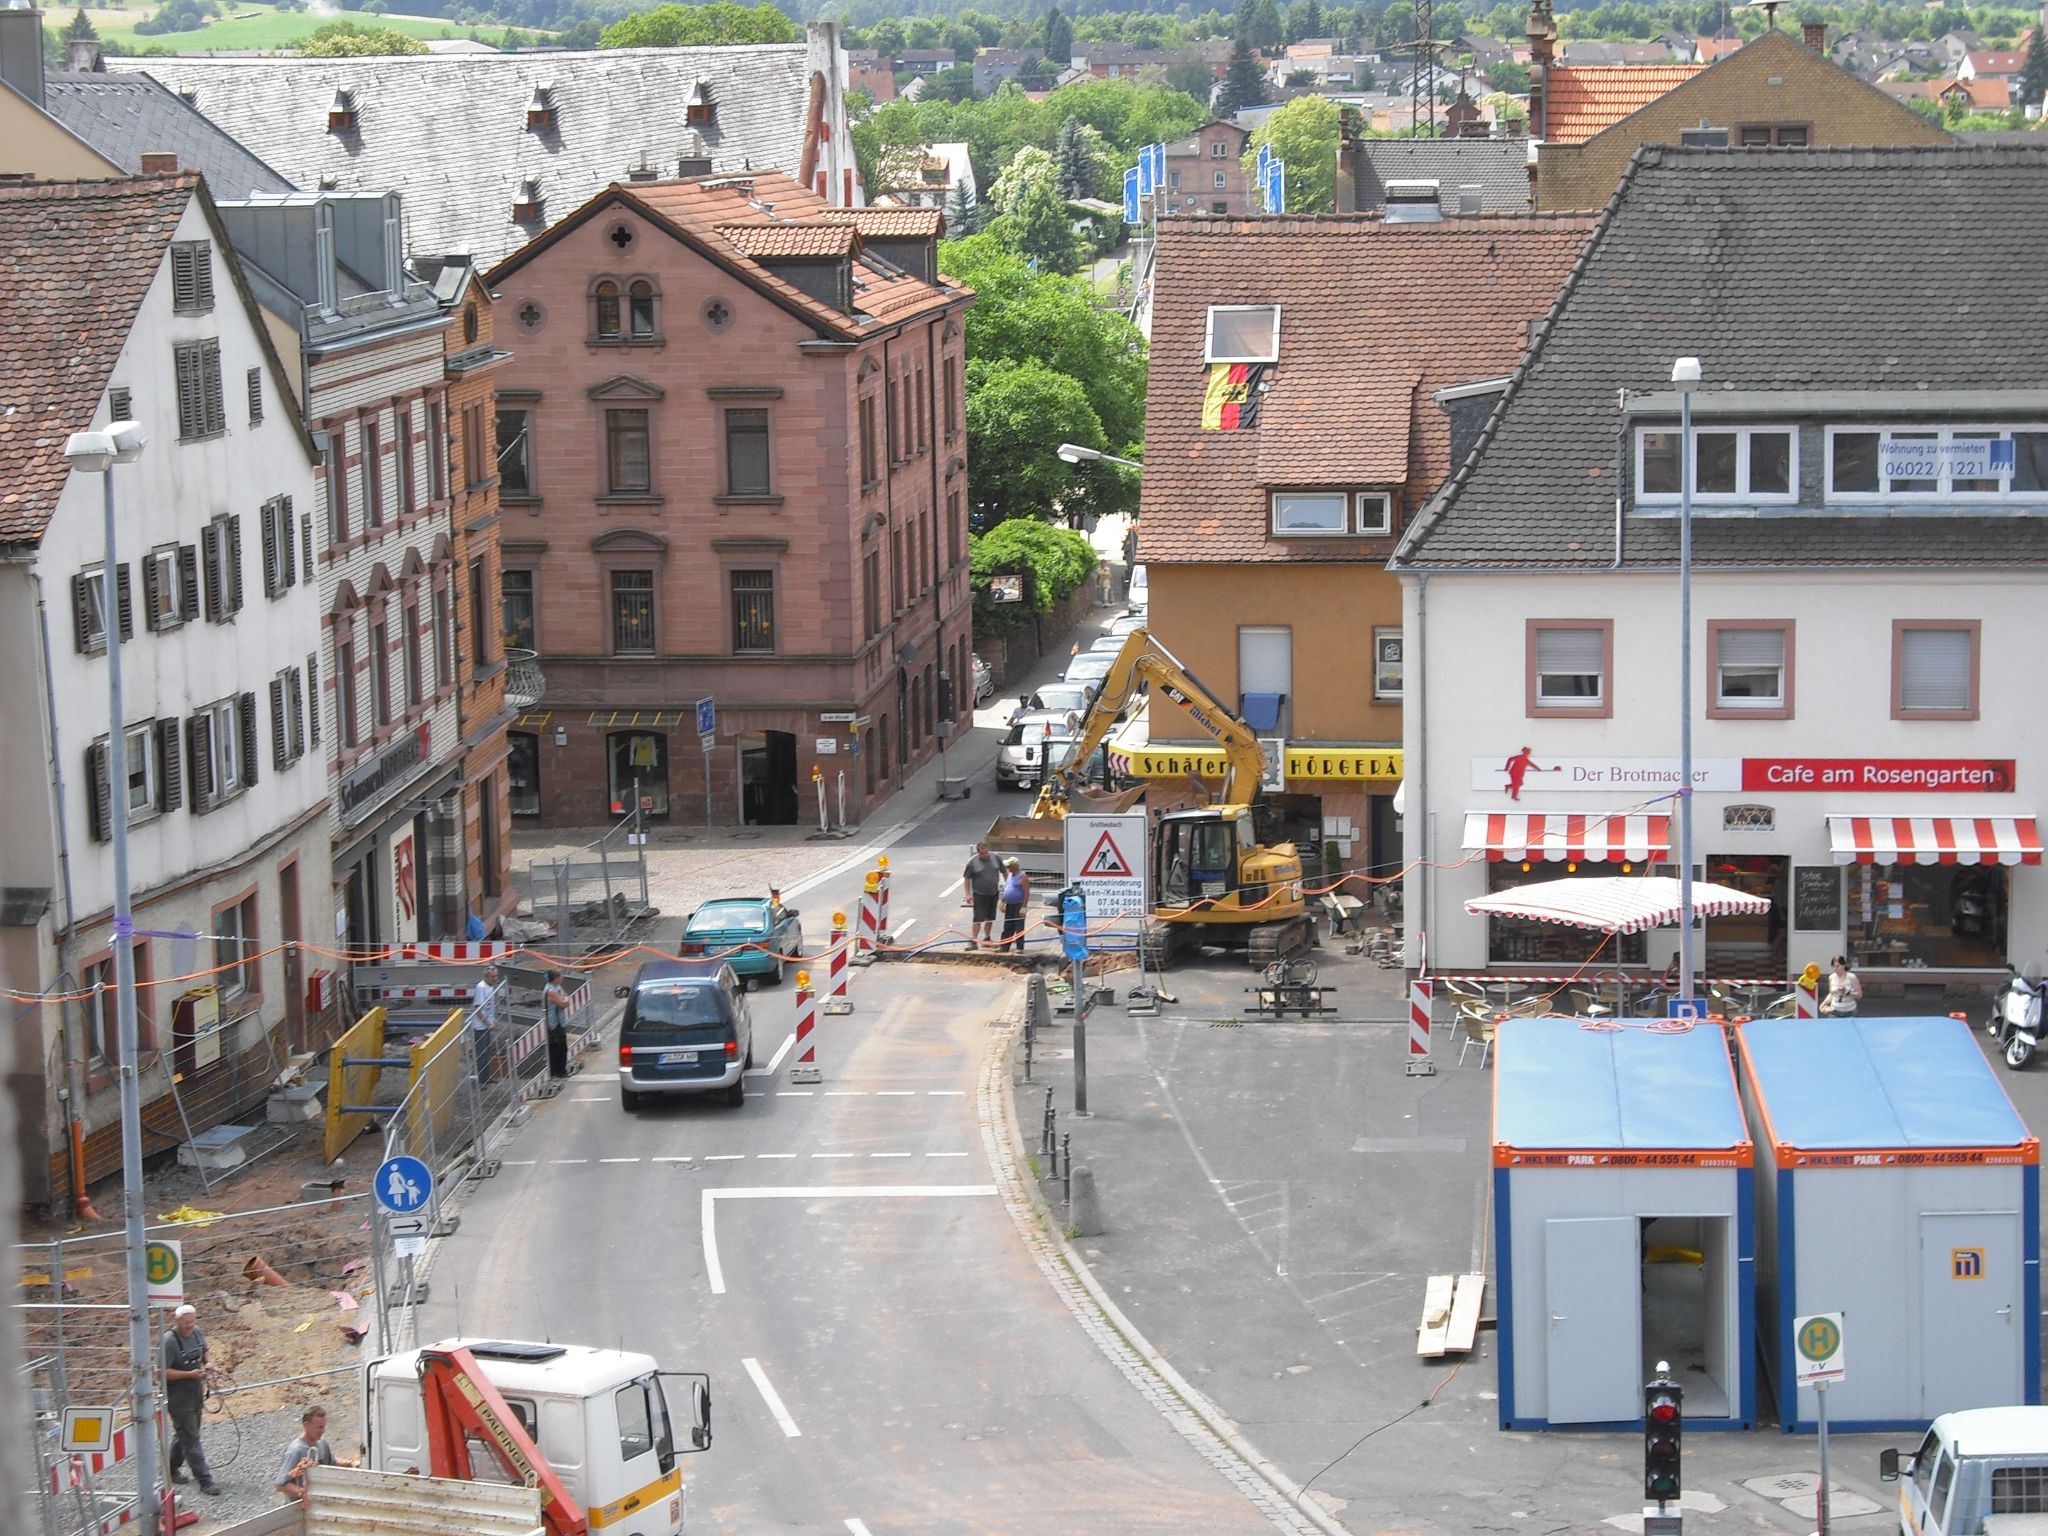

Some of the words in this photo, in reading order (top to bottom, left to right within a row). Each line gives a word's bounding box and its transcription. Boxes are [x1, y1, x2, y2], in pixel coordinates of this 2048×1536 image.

[1880, 443, 1924, 456] Wohnung
[1926, 445, 1938, 453] zu
[1940, 442, 1986, 454] vermieten
[1885, 461, 1933, 476] 06022
[1949, 461, 1984, 475] 1221
[1169, 688, 1185, 704] CAT
[1144, 757, 1227, 774] Schäfer
[1291, 755, 1404, 775] HÖRGERÄ
[1573, 767, 1603, 782] Der
[1610, 767, 1709, 782] Brotmacer
[1767, 765, 1815, 783] Cafe
[1822, 769, 1854, 783] am
[1863, 766, 1994, 788] Rosengarten
[1097, 898, 1142, 906] 07.04.2008
[1610, 1156, 1637, 1165] 0800
[1645, 1155, 1658, 1164] 44
[1660, 1155, 1680, 1164] 555
[1682, 1154, 1697, 1163] 44
[1898, 1154, 1925, 1163] 0800
[1932, 1154, 1945, 1162] 44
[1947, 1153, 1968, 1162] 555
[1969, 1153, 1984, 1161] 44
[482, 1408, 536, 1479] PALFINGER
